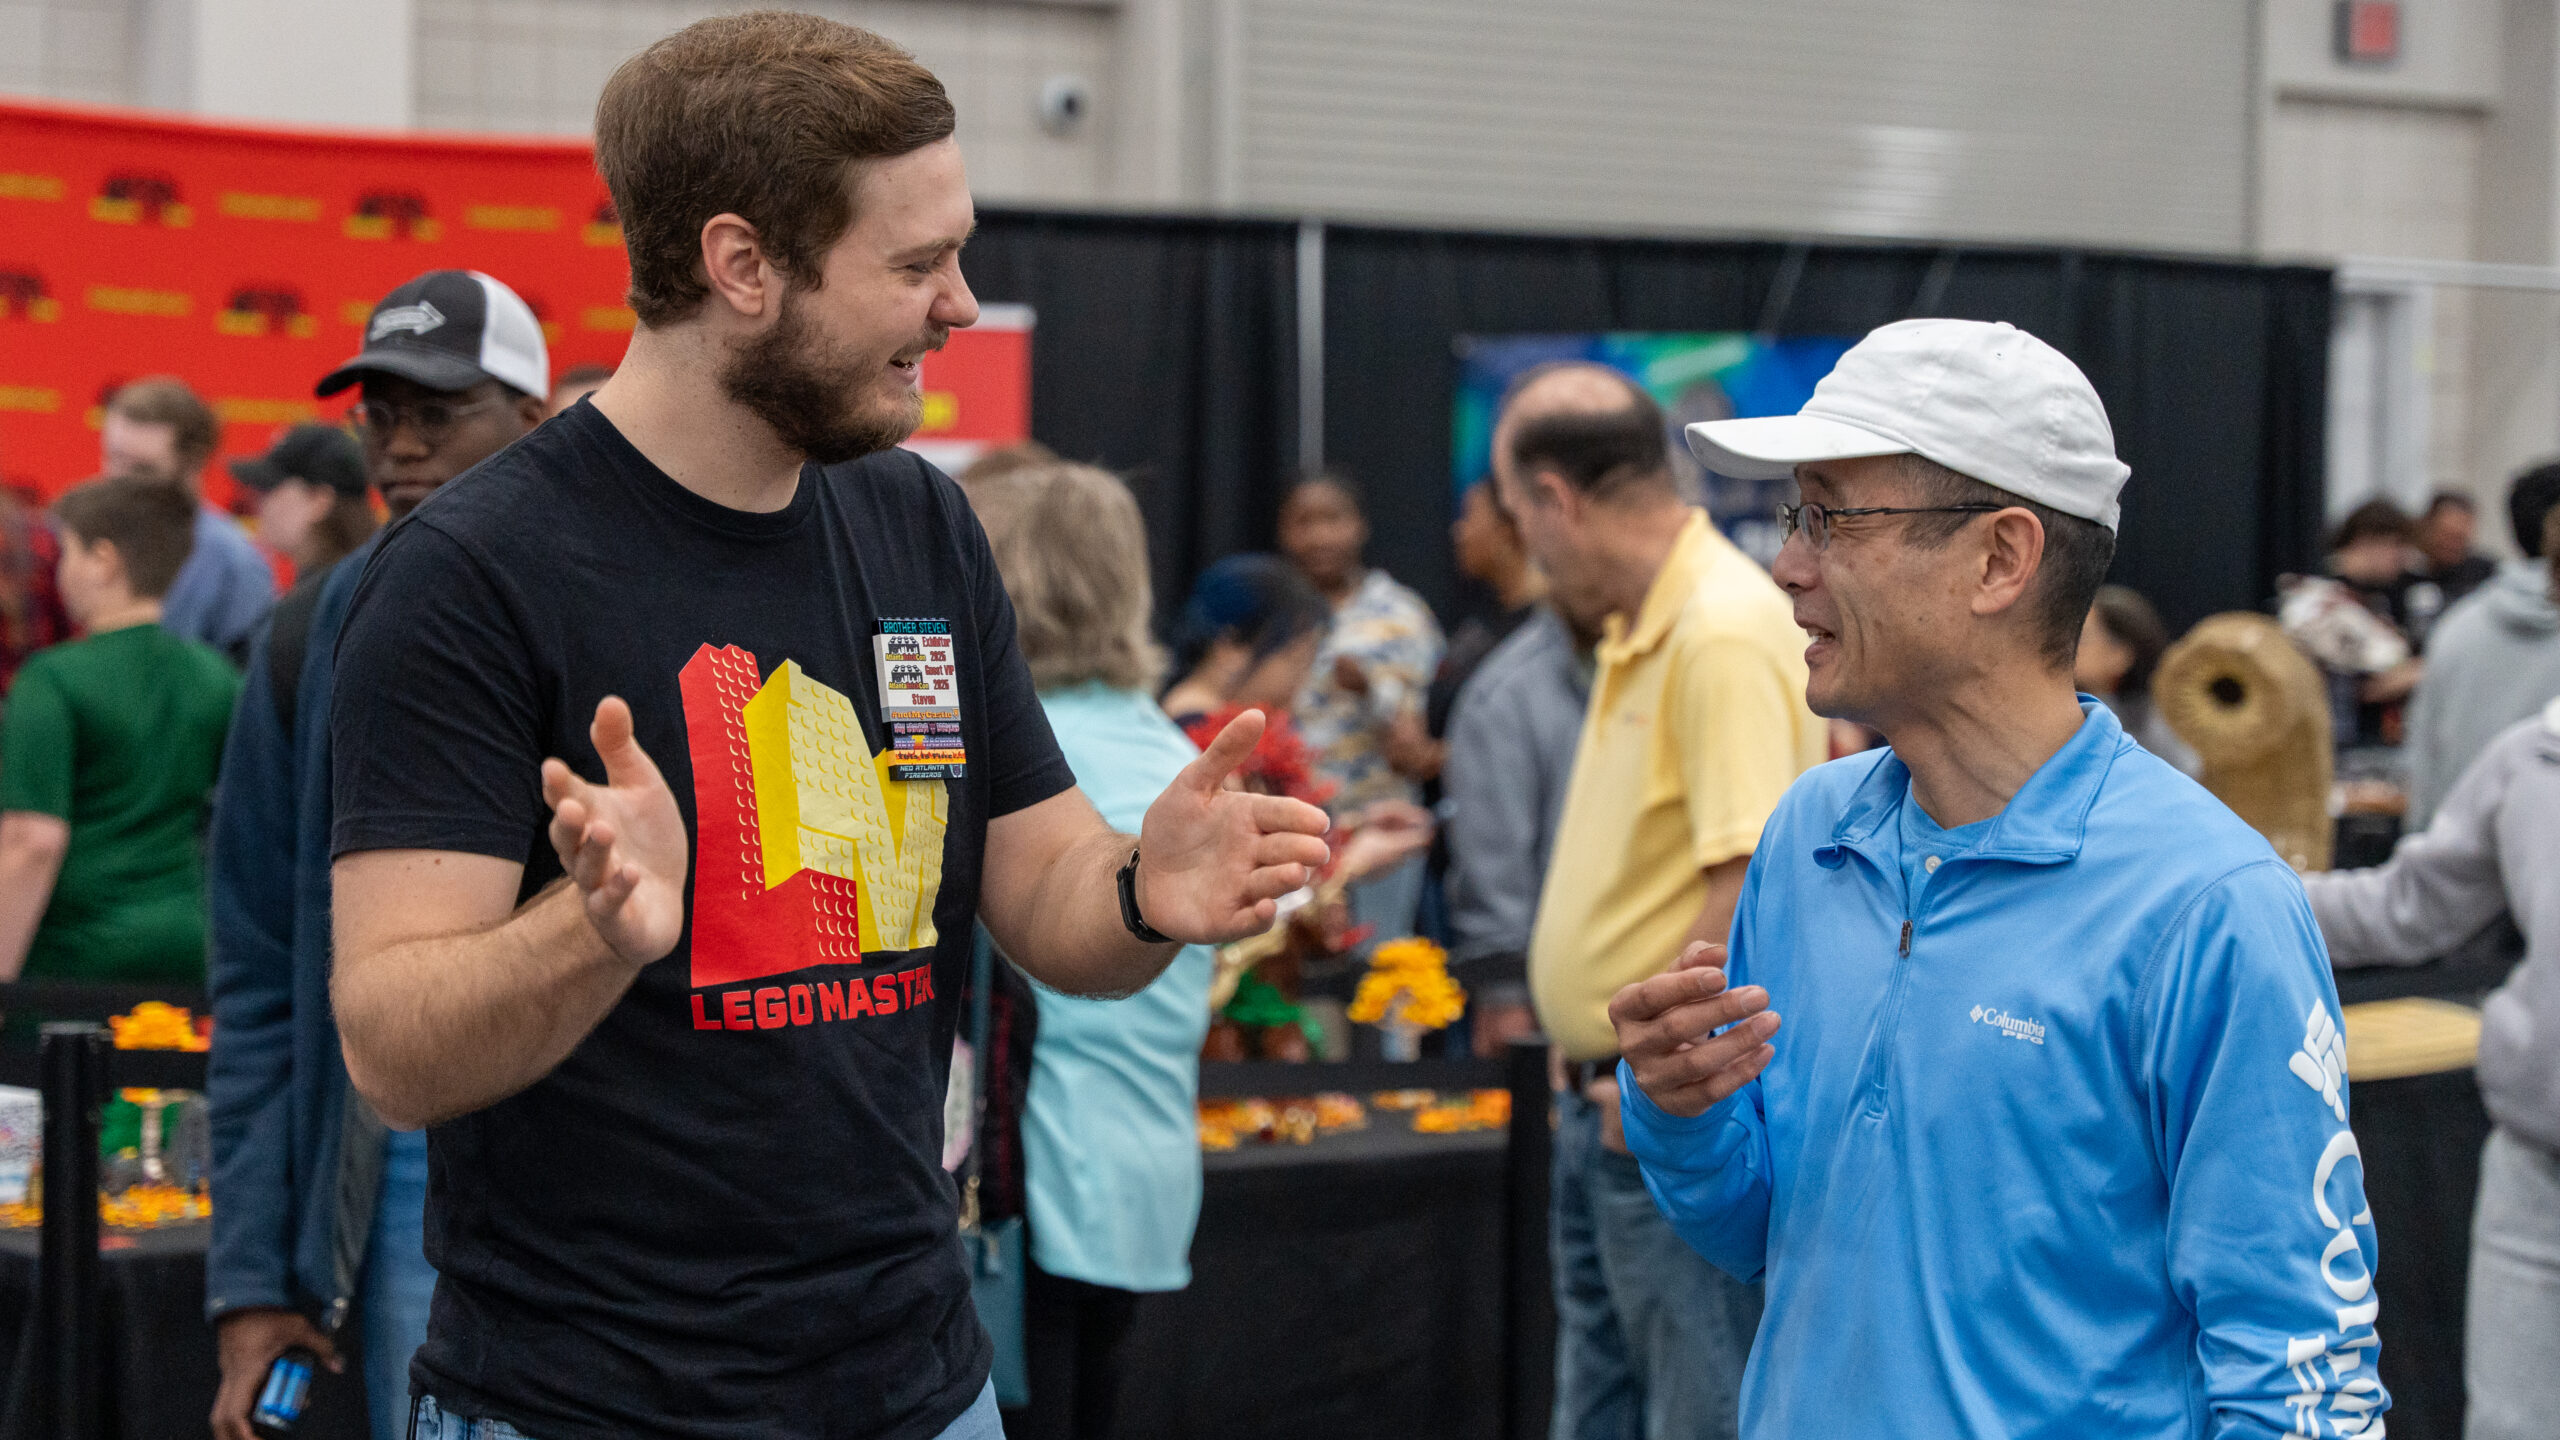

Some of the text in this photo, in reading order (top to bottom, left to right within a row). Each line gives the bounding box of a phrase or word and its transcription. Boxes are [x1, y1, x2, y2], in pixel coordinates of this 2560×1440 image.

[883, 621, 947, 634] BROTHER STEVEN
[922, 636, 951, 648] Exhibitor
[924, 665, 955, 675] Guest VIP
[911, 694, 936, 705] Steven
[1983, 1008, 2045, 1038] Columbia
